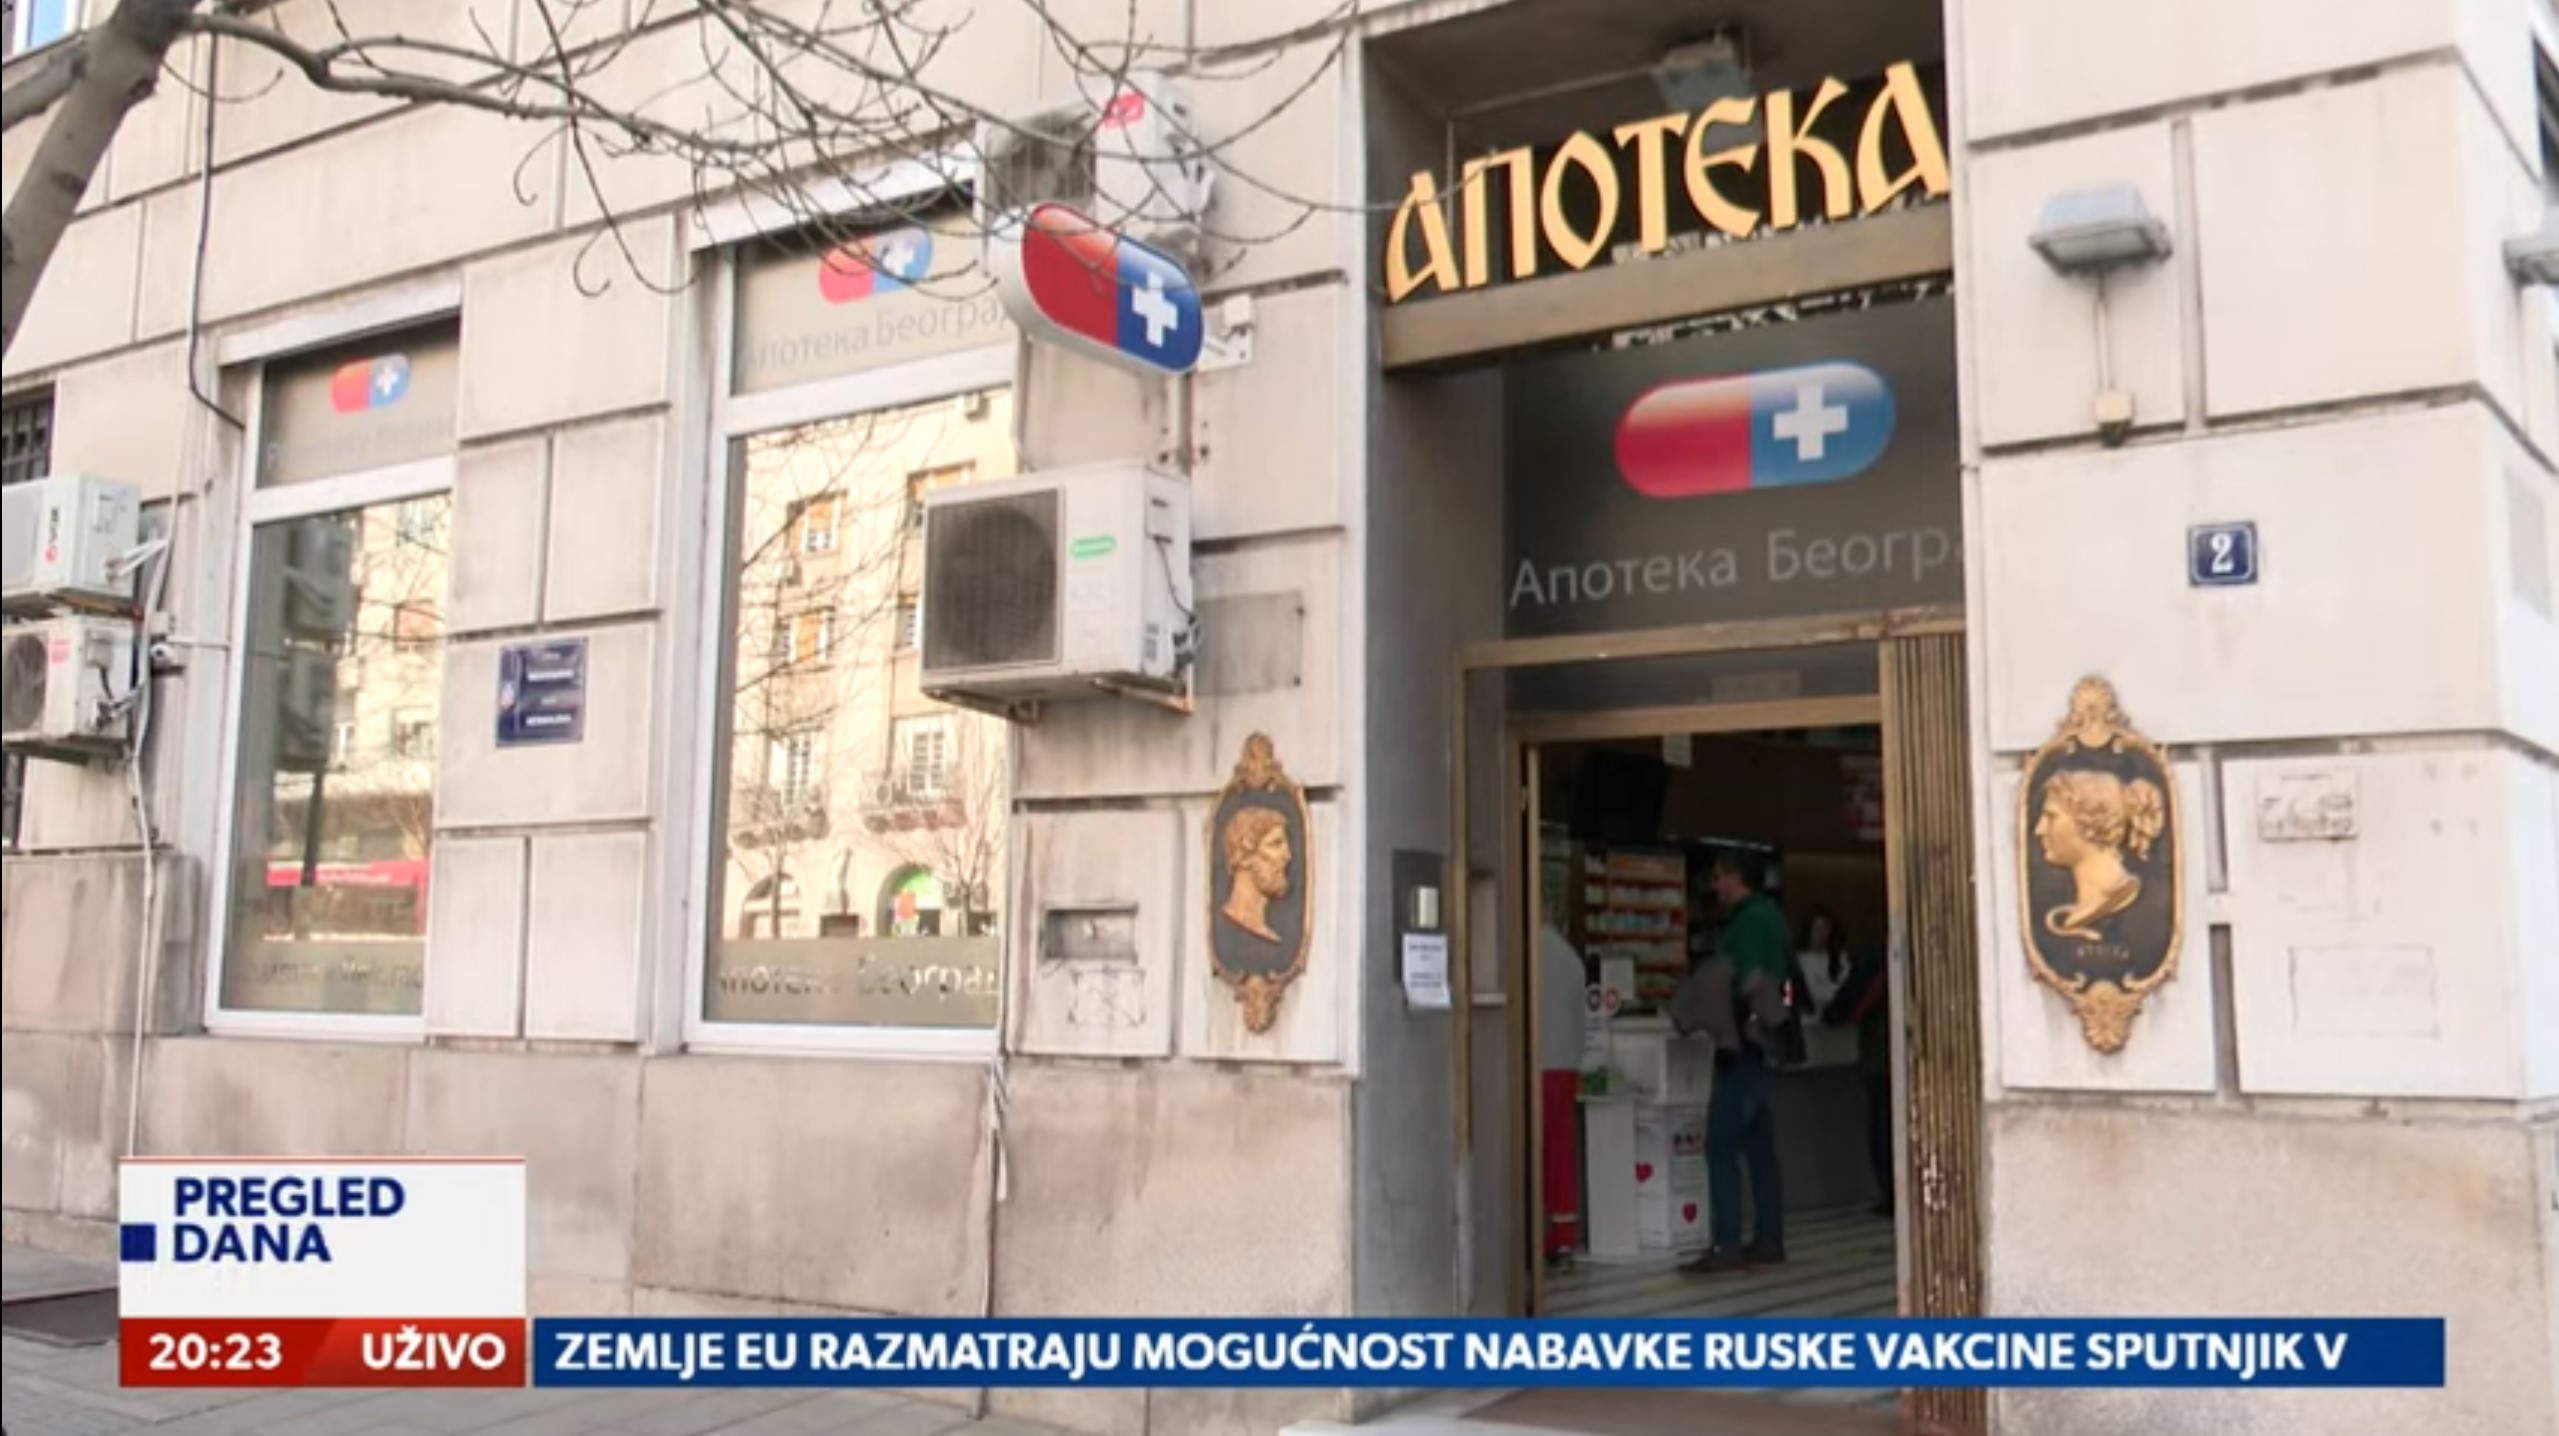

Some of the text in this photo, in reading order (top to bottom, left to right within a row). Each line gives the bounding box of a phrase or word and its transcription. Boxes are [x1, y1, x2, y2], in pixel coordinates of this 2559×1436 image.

[1386, 60, 1953, 304] АПОТЕКА
[1509, 526, 1963, 609] Апотека Беогр
[2211, 532, 2235, 575] 2
